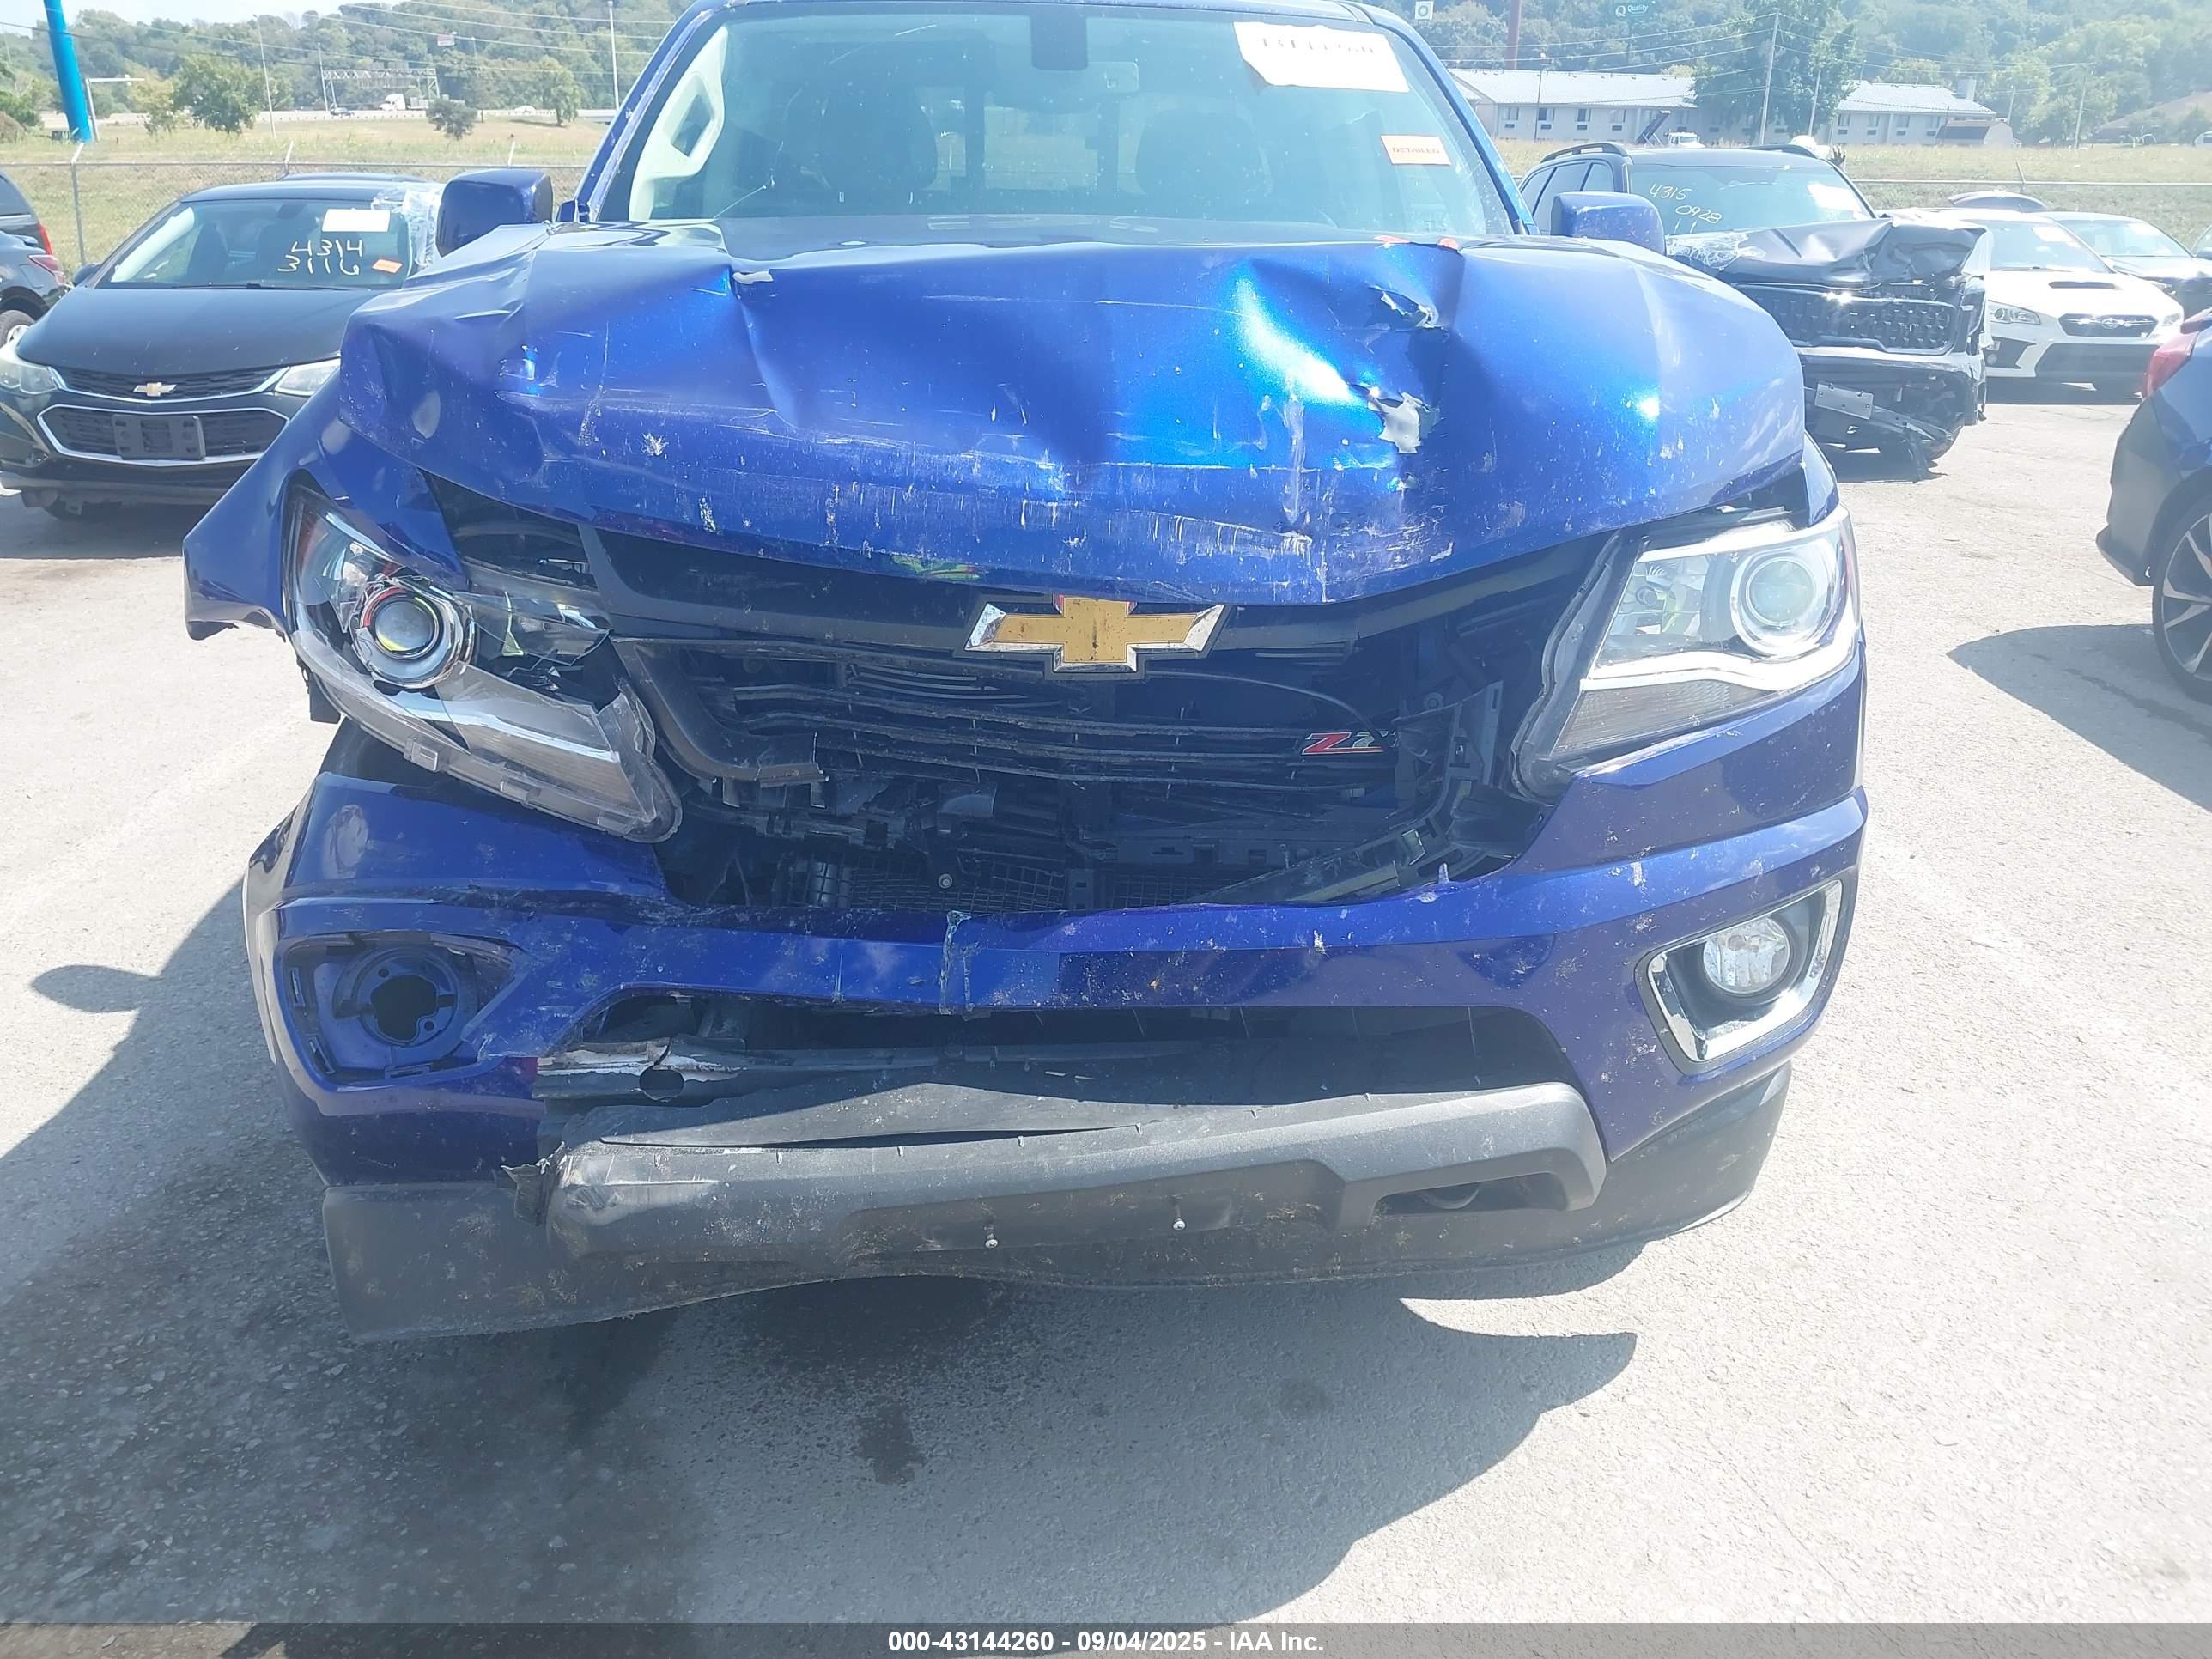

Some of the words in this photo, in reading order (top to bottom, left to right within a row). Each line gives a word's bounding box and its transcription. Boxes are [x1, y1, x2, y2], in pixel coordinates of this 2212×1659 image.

[1649, 183, 1693, 201] 4315
[1674, 204, 1723, 224] 0928
[290, 239, 363, 258] 4314
[276, 254, 360, 276] 3116
